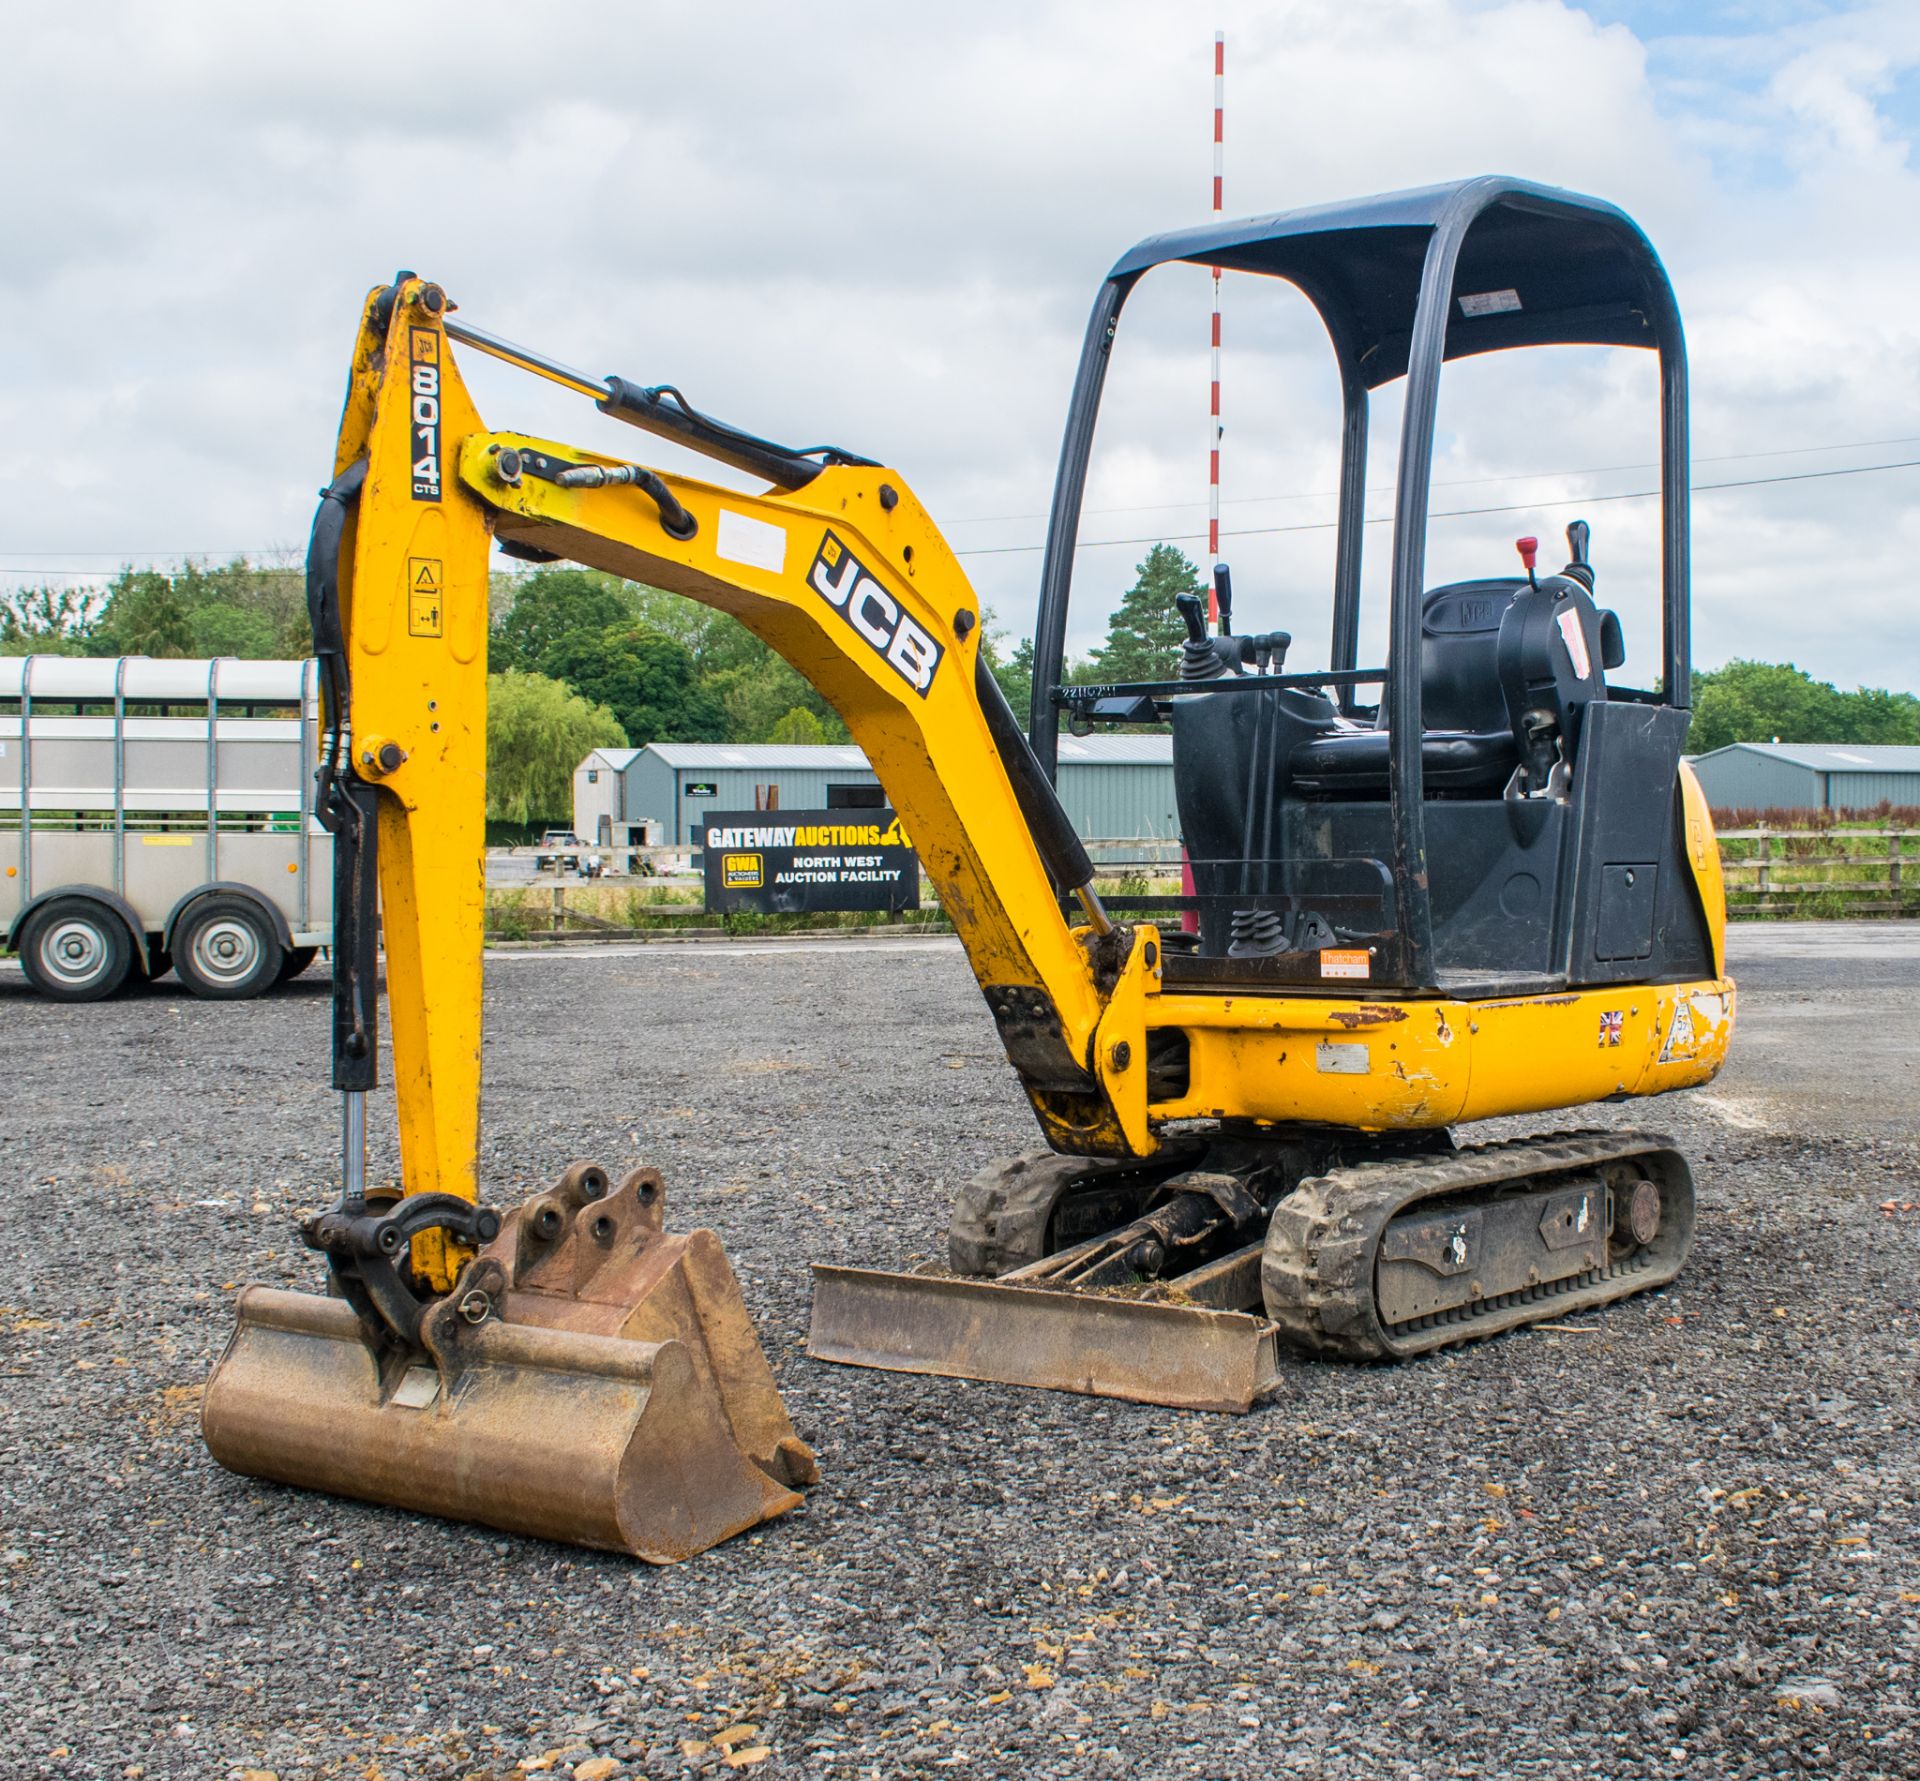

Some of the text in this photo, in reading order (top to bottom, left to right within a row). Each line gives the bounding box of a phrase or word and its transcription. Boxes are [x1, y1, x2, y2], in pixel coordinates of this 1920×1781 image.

[412, 365, 439, 484] 8014
[414, 484, 439, 495] CTS
[813, 557, 938, 690] JCB
[727, 856, 758, 871] GWA
[793, 856, 883, 868] NORTH WEST
[775, 870, 901, 883] AUCTION FACILITY
[1322, 952, 1367, 964] Thatcham
